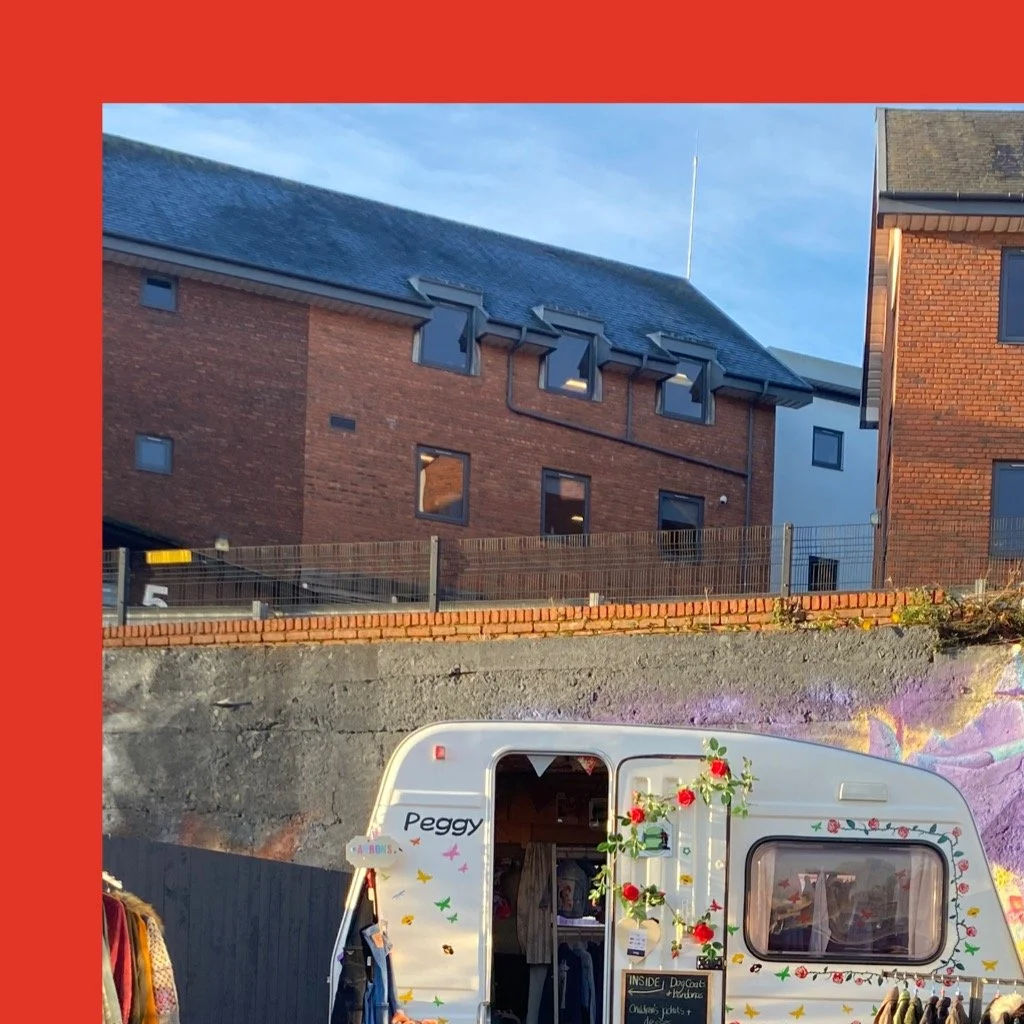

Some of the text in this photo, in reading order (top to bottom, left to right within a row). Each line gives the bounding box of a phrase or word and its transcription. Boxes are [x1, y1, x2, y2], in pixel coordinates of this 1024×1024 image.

[403, 811, 484, 837] Peggy
[629, 975, 660, 987] INSIDE
[670, 976, 705, 994] Dog Coats
